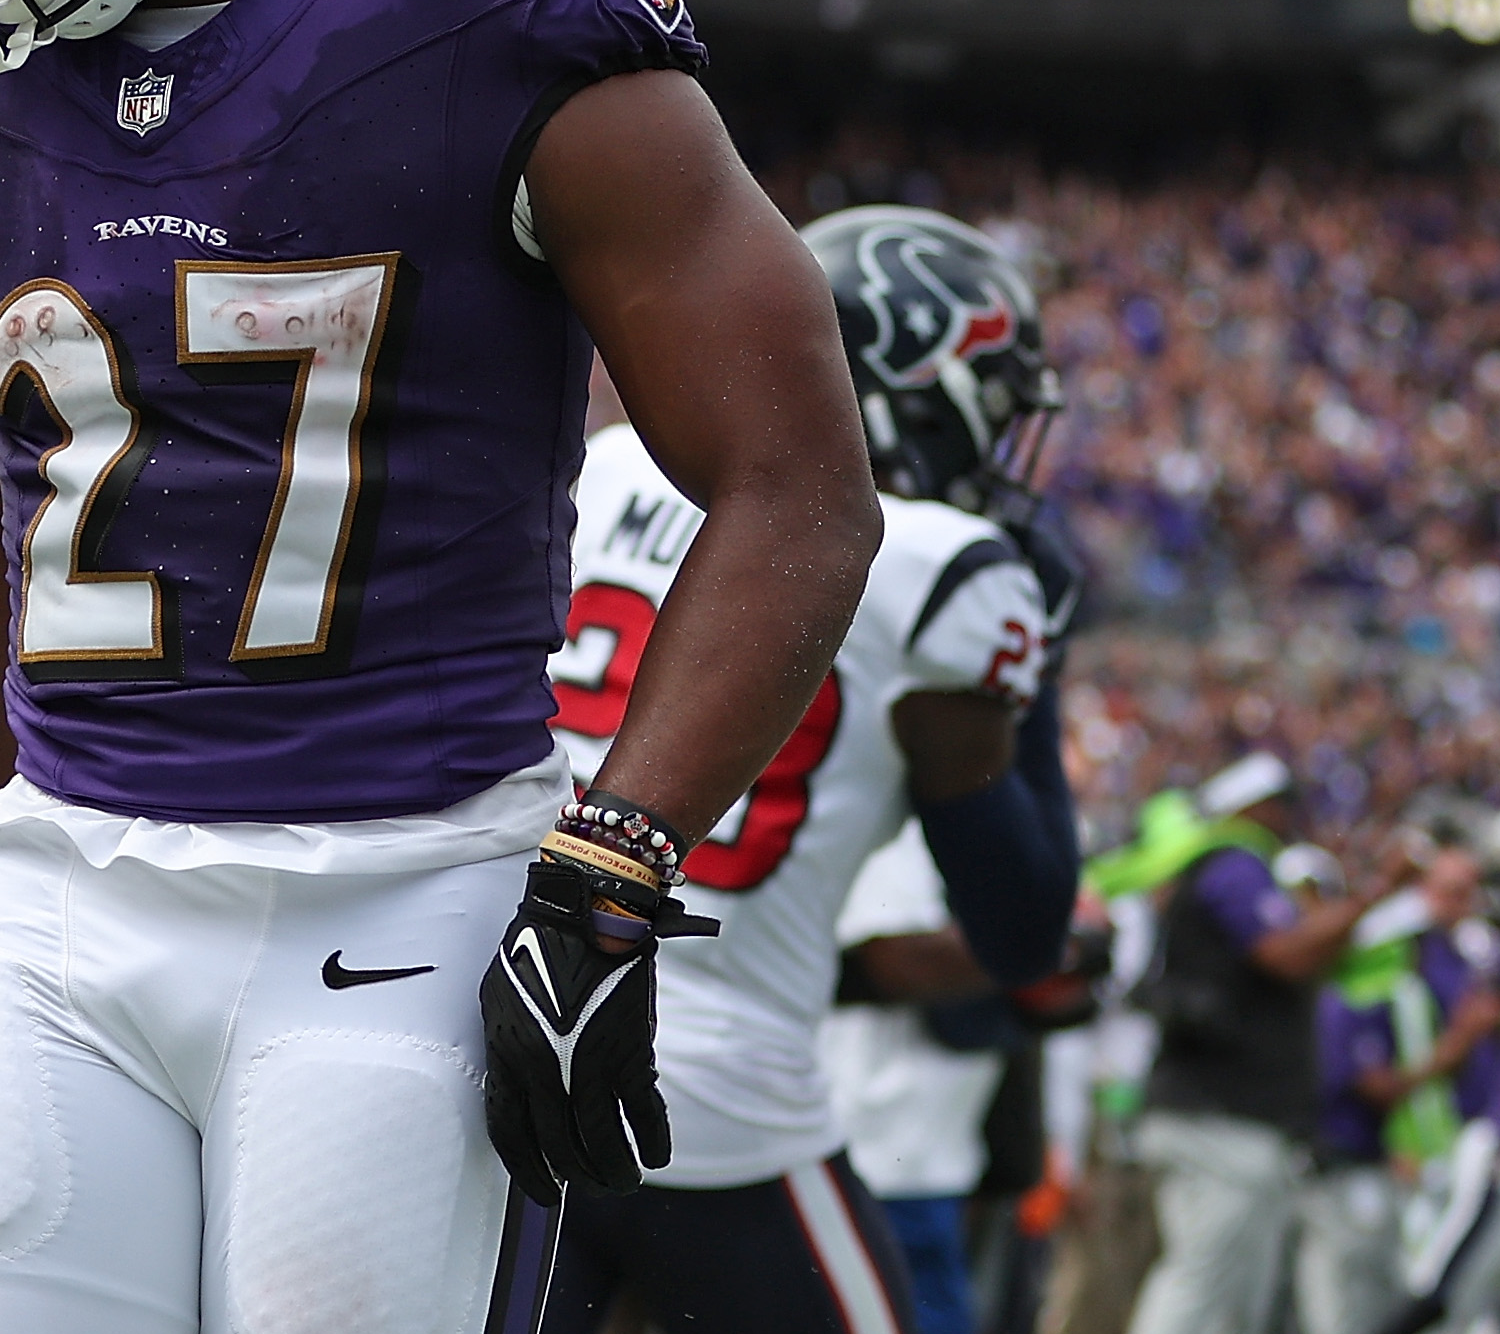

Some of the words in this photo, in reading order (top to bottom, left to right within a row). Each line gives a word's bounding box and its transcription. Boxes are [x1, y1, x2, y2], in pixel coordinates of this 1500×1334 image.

[125, 97, 161, 123] NFL
[93, 215, 228, 246] RAVENS
[555, 838, 590, 855] FORCES
[592, 851, 634, 875] SPECIAL
